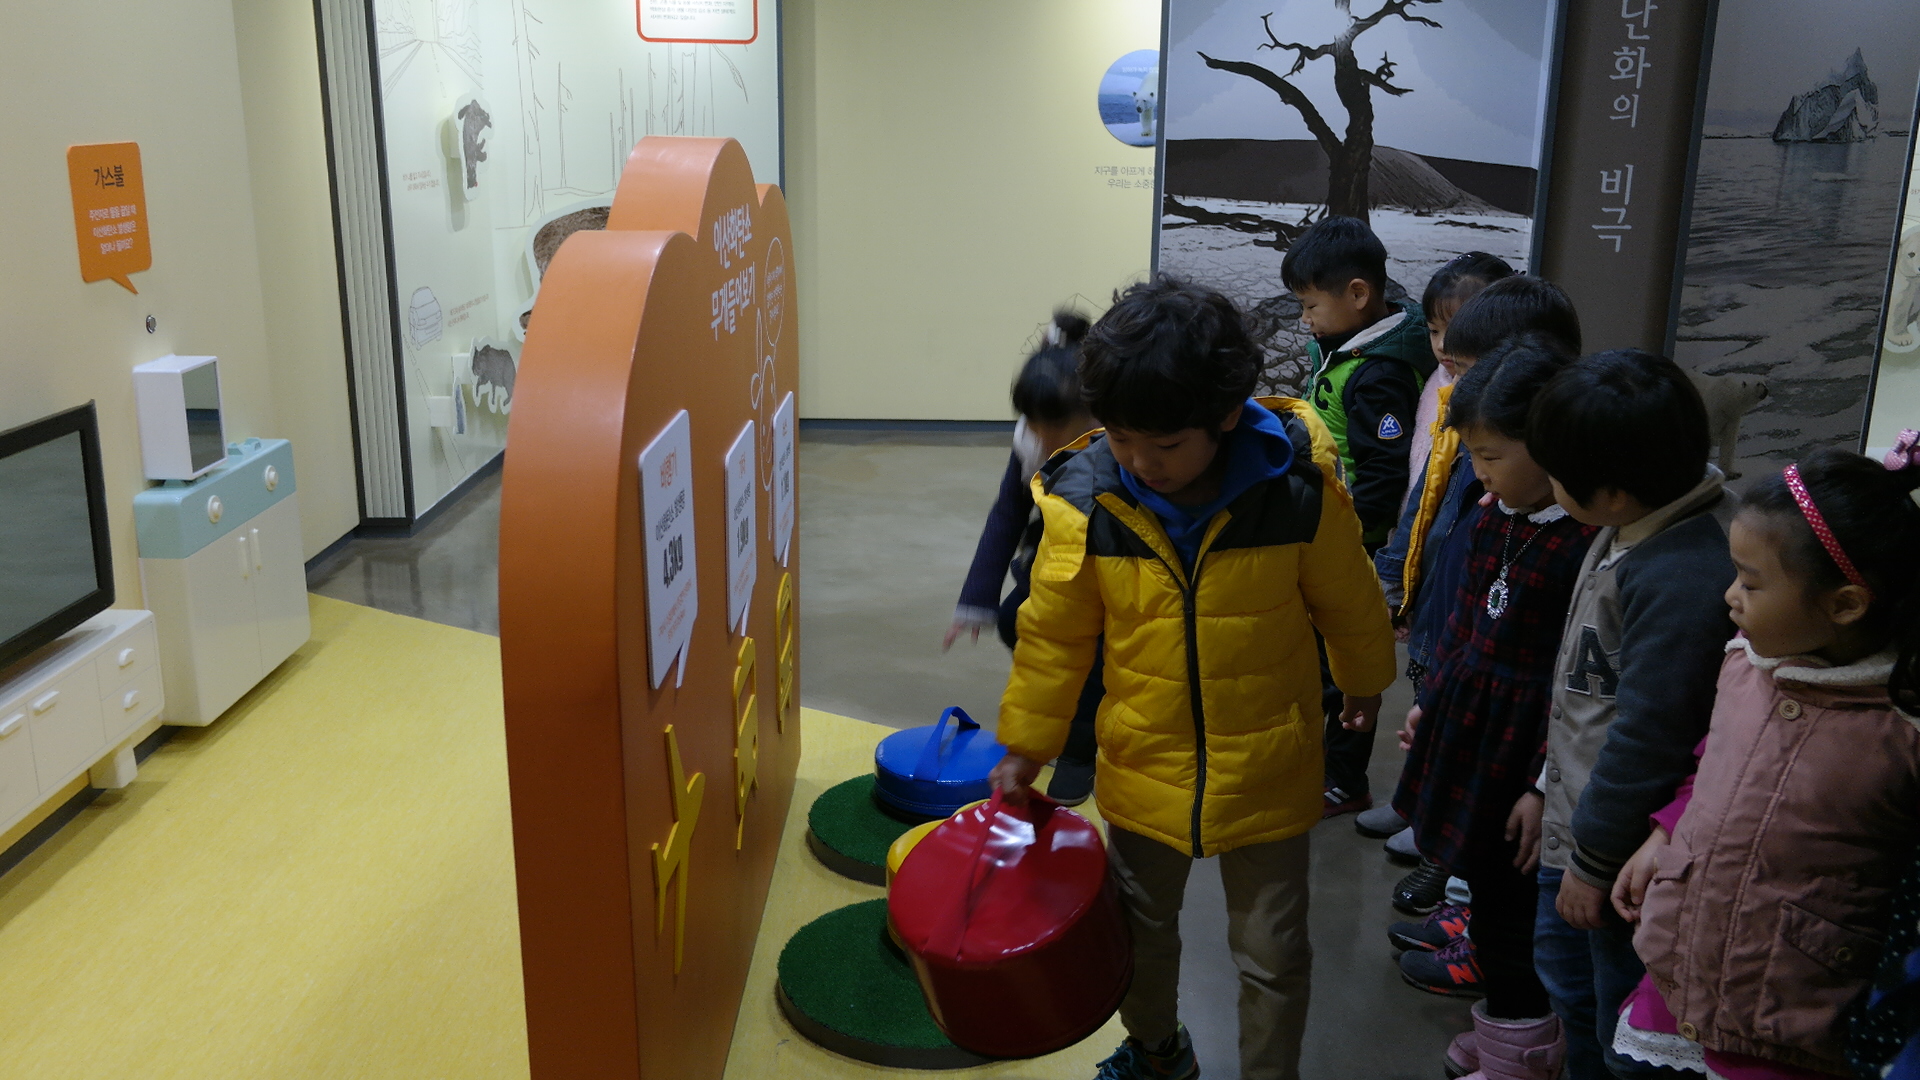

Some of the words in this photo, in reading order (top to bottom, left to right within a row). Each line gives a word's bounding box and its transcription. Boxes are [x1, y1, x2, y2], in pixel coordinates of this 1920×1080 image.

[94, 165, 125, 189] 가스불
[1094, 165, 1118, 176] 지구를
[1120, 165, 1145, 176] 아프게
[1108, 178, 1131, 189] 우리는
[1592, 164, 1634, 253] 비극
[713, 203, 752, 269] 이산화탄소
[660, 446, 677, 489] 비행기
[663, 533, 683, 588] 4.3kg
[1565, 623, 1620, 699] A
